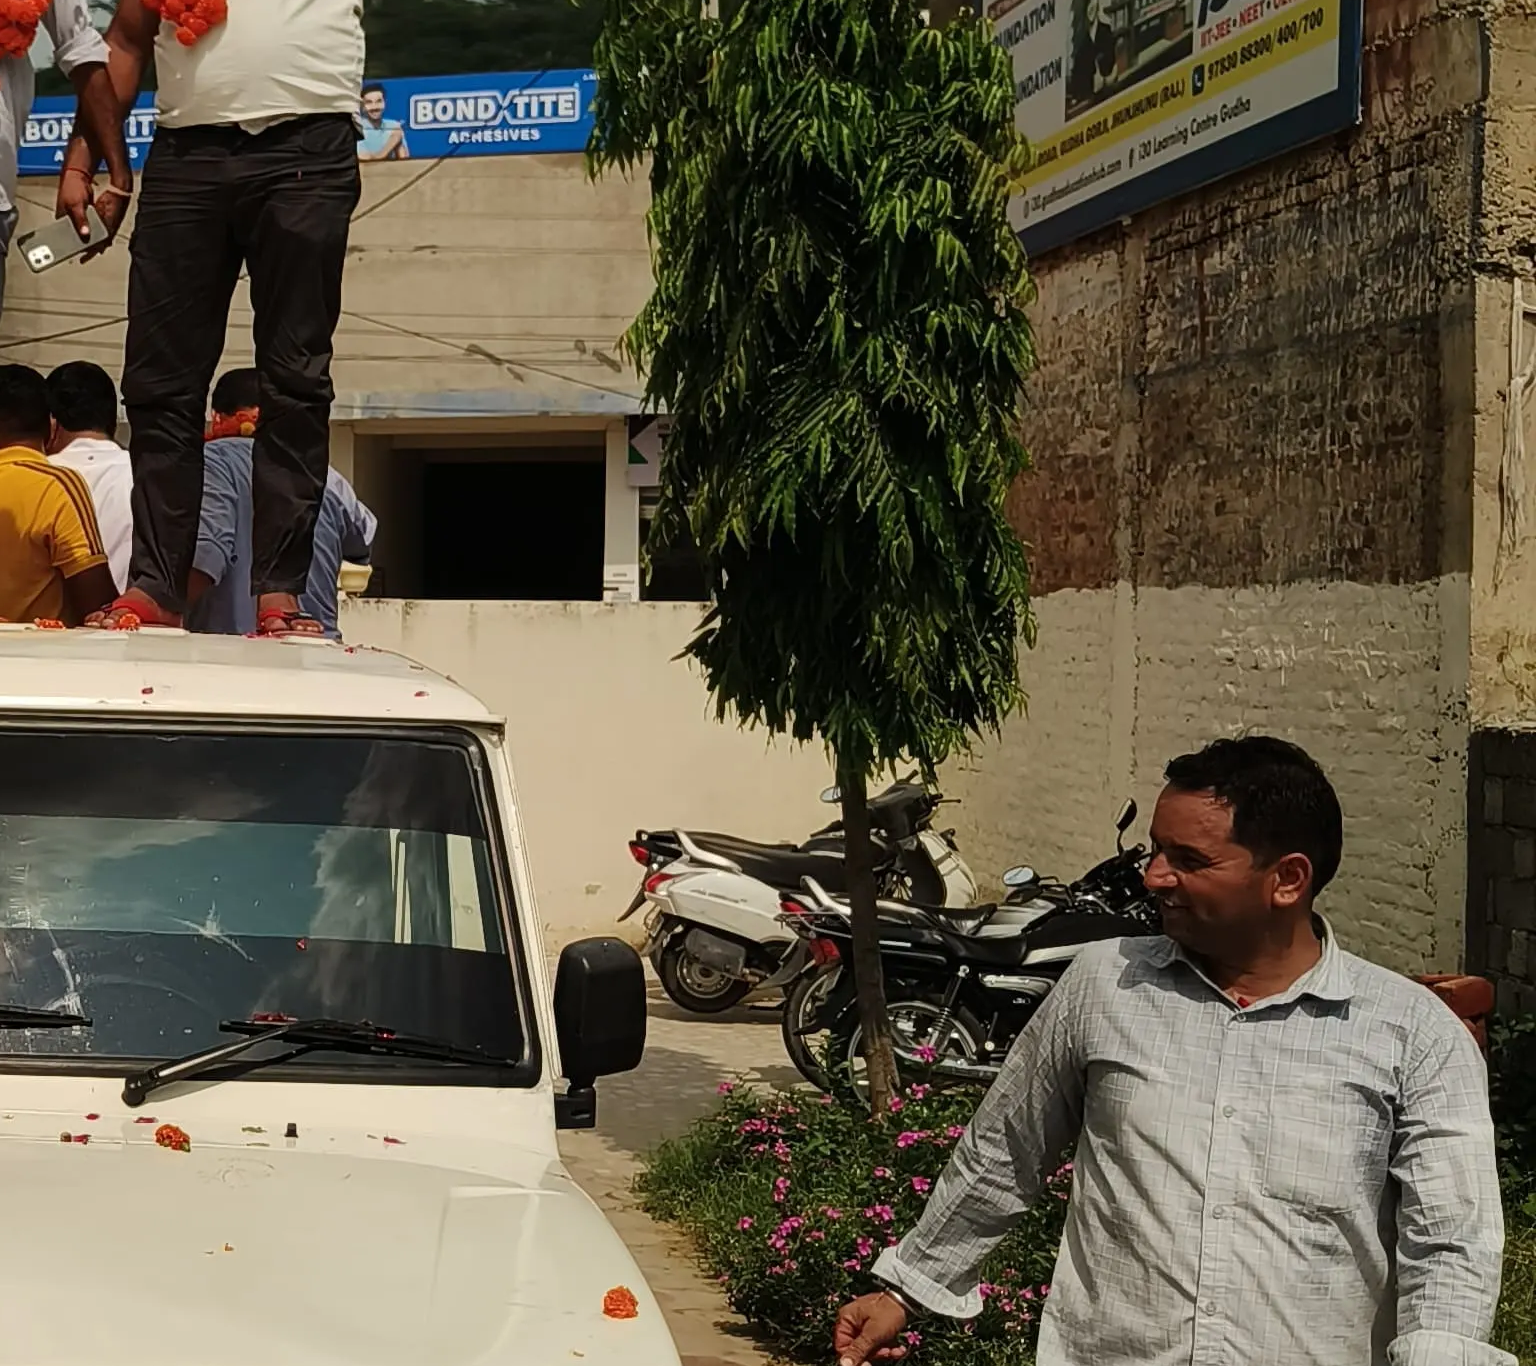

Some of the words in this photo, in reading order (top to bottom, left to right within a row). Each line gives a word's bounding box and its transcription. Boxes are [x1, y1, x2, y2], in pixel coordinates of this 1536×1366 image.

[448, 128, 541, 145] ADHESIVES
[1153, 126, 1188, 154] Learning
[1191, 113, 1217, 136] Centre
